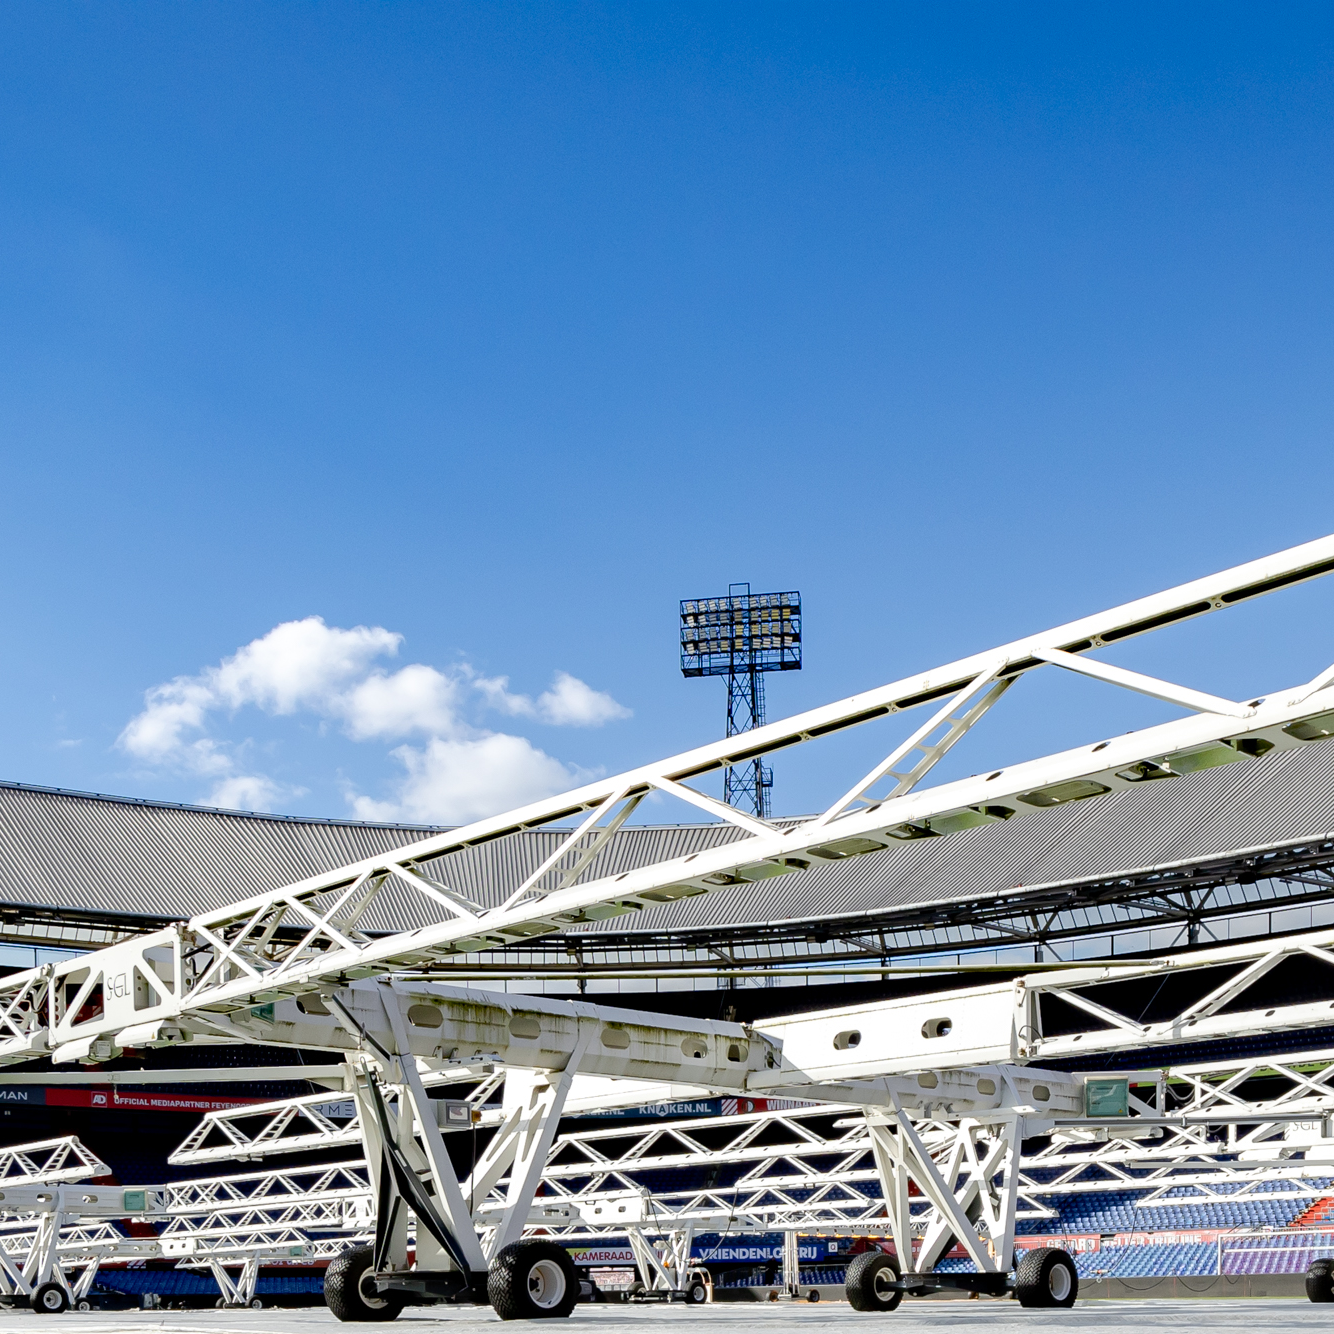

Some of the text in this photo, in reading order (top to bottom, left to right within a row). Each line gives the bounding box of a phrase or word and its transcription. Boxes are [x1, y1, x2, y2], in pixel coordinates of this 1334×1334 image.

[114, 1097, 149, 1106] OFFICIAL
[151, 1099, 210, 1109] MEDIAPARTNER
[639, 1102, 712, 1117] KNAKEN.NL
[698, 1246, 818, 1260] VRIENDENLOERIJ
